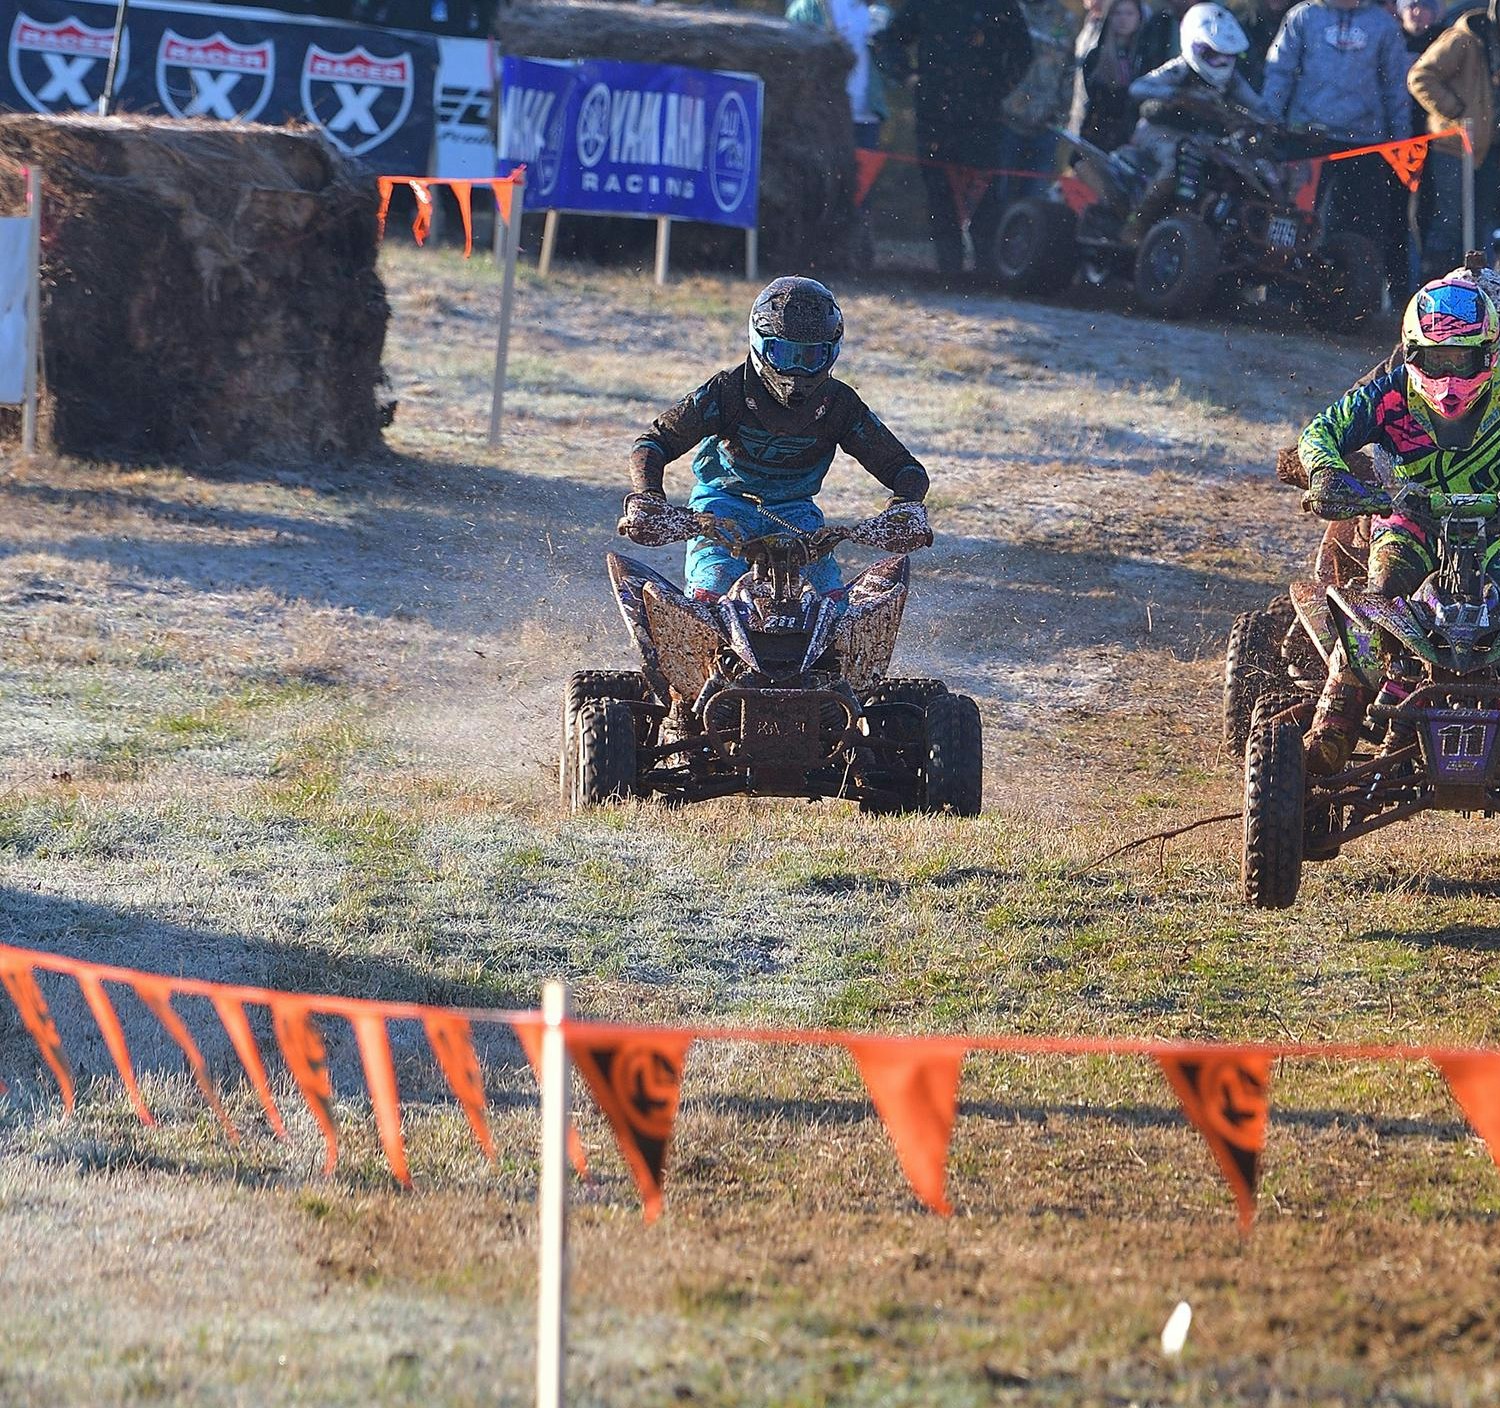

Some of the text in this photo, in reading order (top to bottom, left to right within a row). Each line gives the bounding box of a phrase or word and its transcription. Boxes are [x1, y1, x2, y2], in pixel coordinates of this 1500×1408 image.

[168, 46, 261, 67] RACER
[314, 62, 401, 80] RACER
[36, 53, 97, 106] X
[182, 69, 241, 120] X
[330, 82, 383, 135] X
[581, 172, 695, 199] RACING
[1438, 724, 1487, 757] 11
